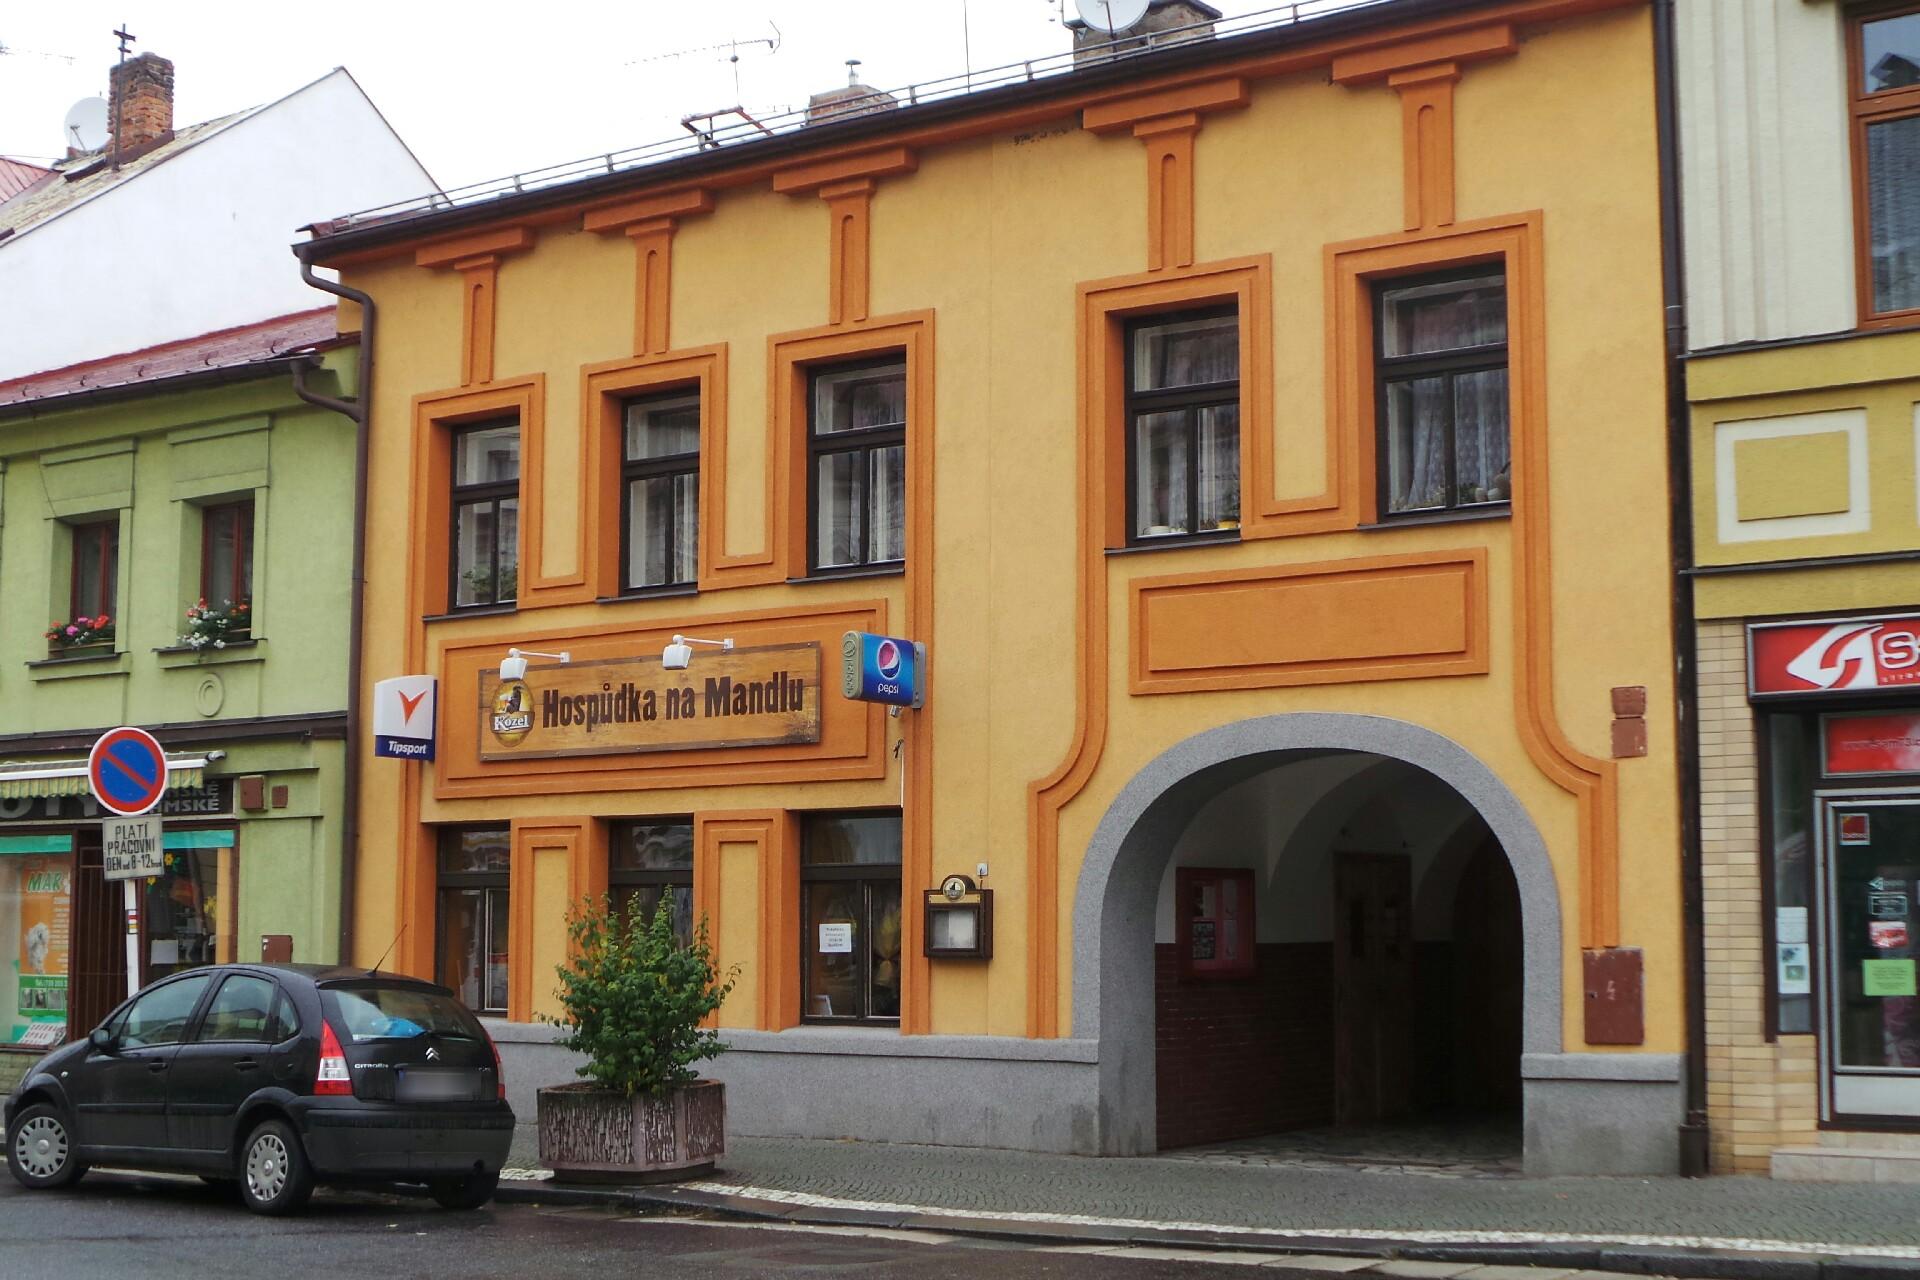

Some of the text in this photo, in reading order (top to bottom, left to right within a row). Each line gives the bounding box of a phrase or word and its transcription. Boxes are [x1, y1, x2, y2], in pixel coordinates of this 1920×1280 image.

[877, 683, 899, 695] pepsi
[543, 683, 657, 732] Hospůdka
[666, 687, 696, 720] na
[704, 671, 804, 718] Mandlu
[494, 715, 530, 731] Kozel
[388, 740, 427, 755] Tipsport
[115, 821, 150, 840] PLATÍ
[106, 856, 122, 871] DEN
